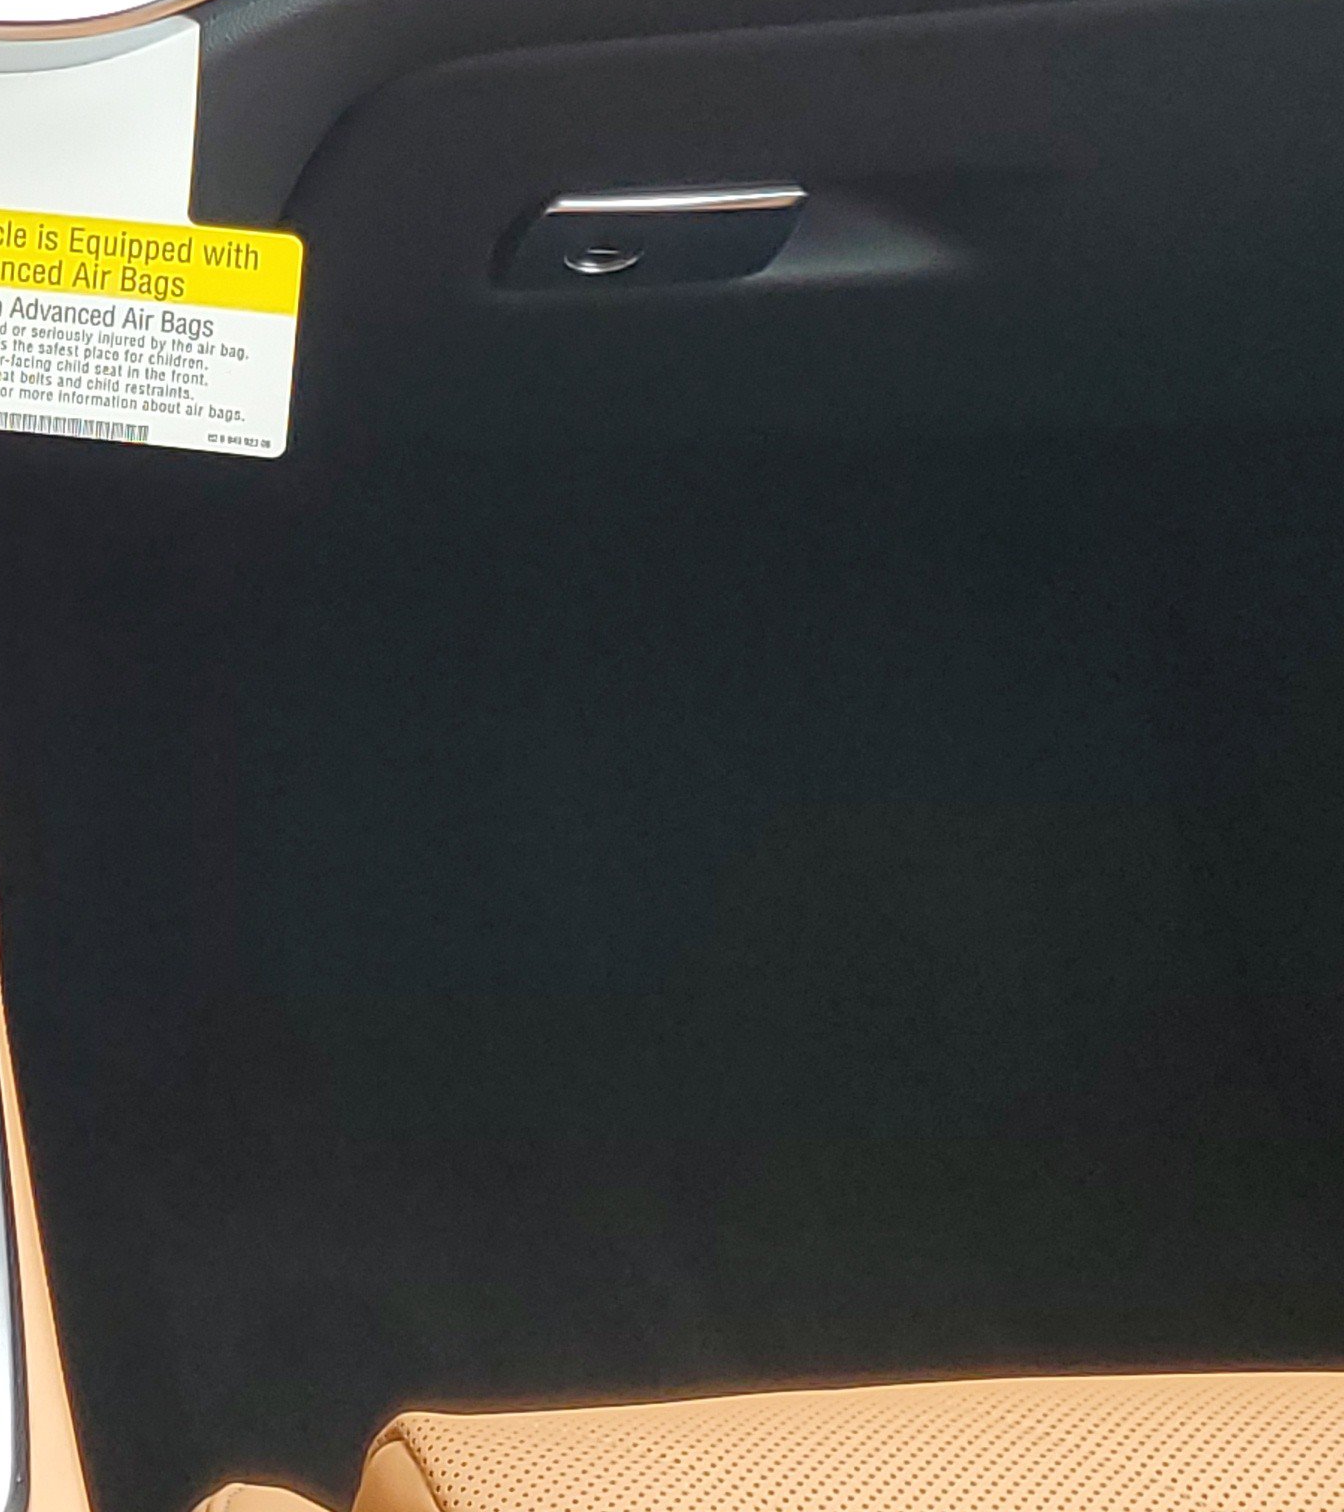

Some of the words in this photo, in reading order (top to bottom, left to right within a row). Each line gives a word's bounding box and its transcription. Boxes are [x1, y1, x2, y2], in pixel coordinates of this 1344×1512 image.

[37, 224, 58, 251] is
[69, 227, 193, 265] Equipped
[204, 241, 259, 271] with
[72, 262, 111, 290] Air
[120, 266, 185, 301] Bags
[10, 296, 116, 327] Advanced
[122, 307, 154, 331] Air
[161, 310, 214, 341] Bags
[12, 324, 26, 336] or
[32, 327, 93, 346] seriously
[98, 331, 145, 349] injured
[151, 336, 166, 354] by
[198, 342, 216, 355] air
[221, 343, 249, 361] bag.
[13, 339, 33, 353] the
[38, 341, 79, 357] safest
[124, 348, 143, 363] for
[57, 359, 89, 374] child
[95, 363, 122, 377] seat
[127, 366, 139, 379] in
[145, 367, 166, 381] the
[57, 375, 82, 389] and
[87, 377, 119, 392] child
[19, 388, 53, 402] more
[58, 390, 137, 409] information
[142, 399, 181, 414] about
[186, 402, 204, 417] air
